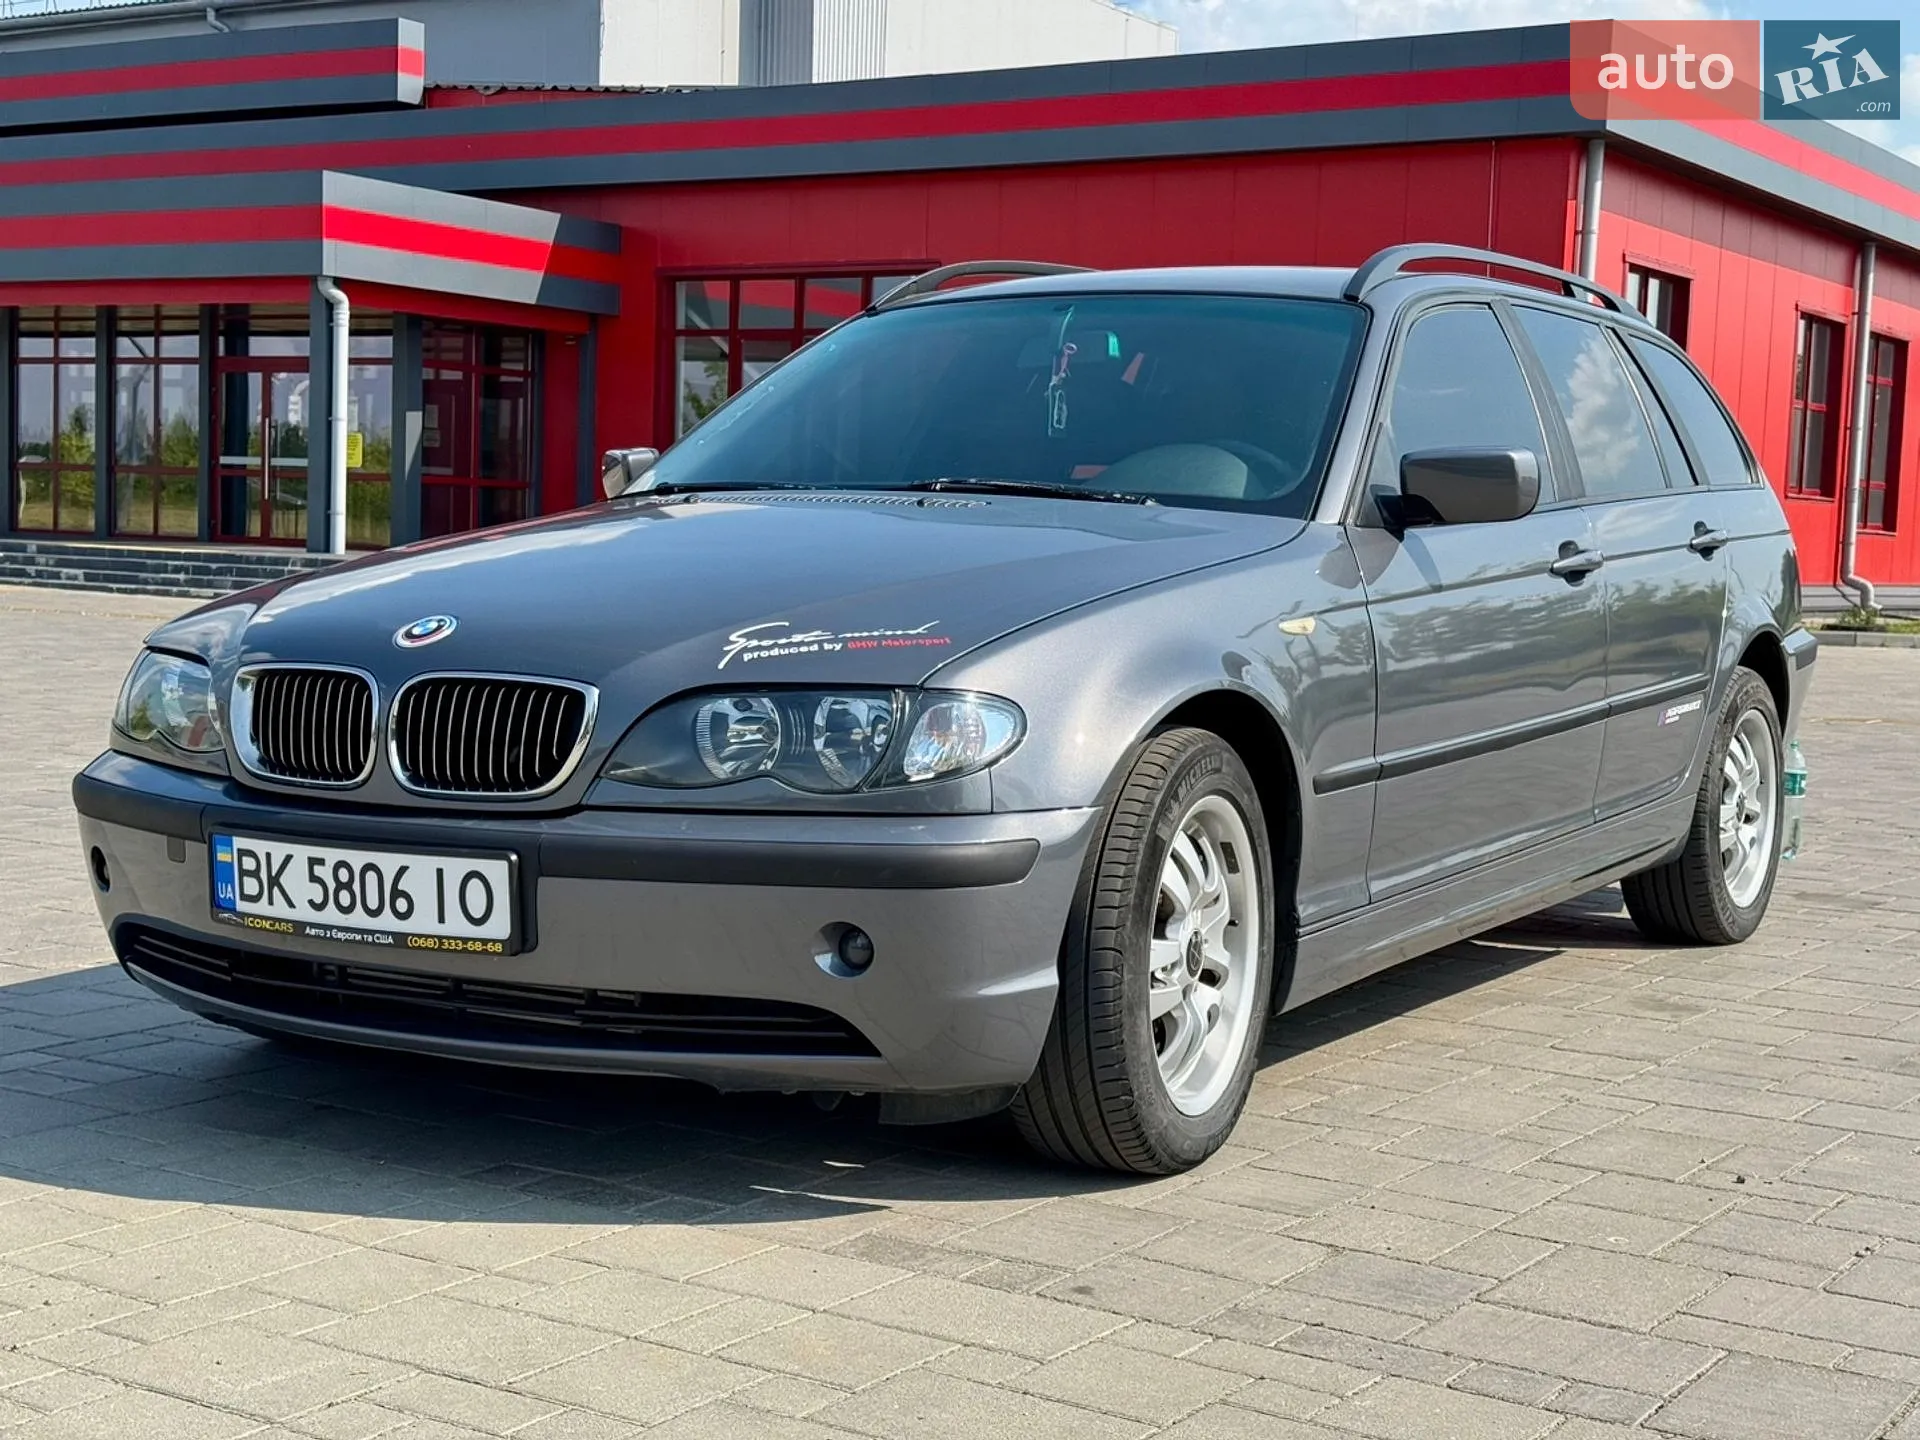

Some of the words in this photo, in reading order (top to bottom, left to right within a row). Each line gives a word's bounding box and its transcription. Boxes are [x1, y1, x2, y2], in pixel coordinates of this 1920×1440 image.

[742, 643, 819, 662] produced
[823, 642, 843, 651] by
[881, 636, 952, 648] Motorsport
[217, 881, 235, 900] UA
[237, 847, 297, 909] BK
[306, 856, 415, 921] 5806
[435, 867, 494, 927] IO
[244, 915, 295, 933] ICONCARS
[304, 925, 325, 937] Авто
[331, 928, 363, 942] Європи
[363, 933, 373, 943] та
[373, 933, 395, 945] США
[407, 935, 439, 949] (068)
[441, 938, 503, 953] 333-68-68
